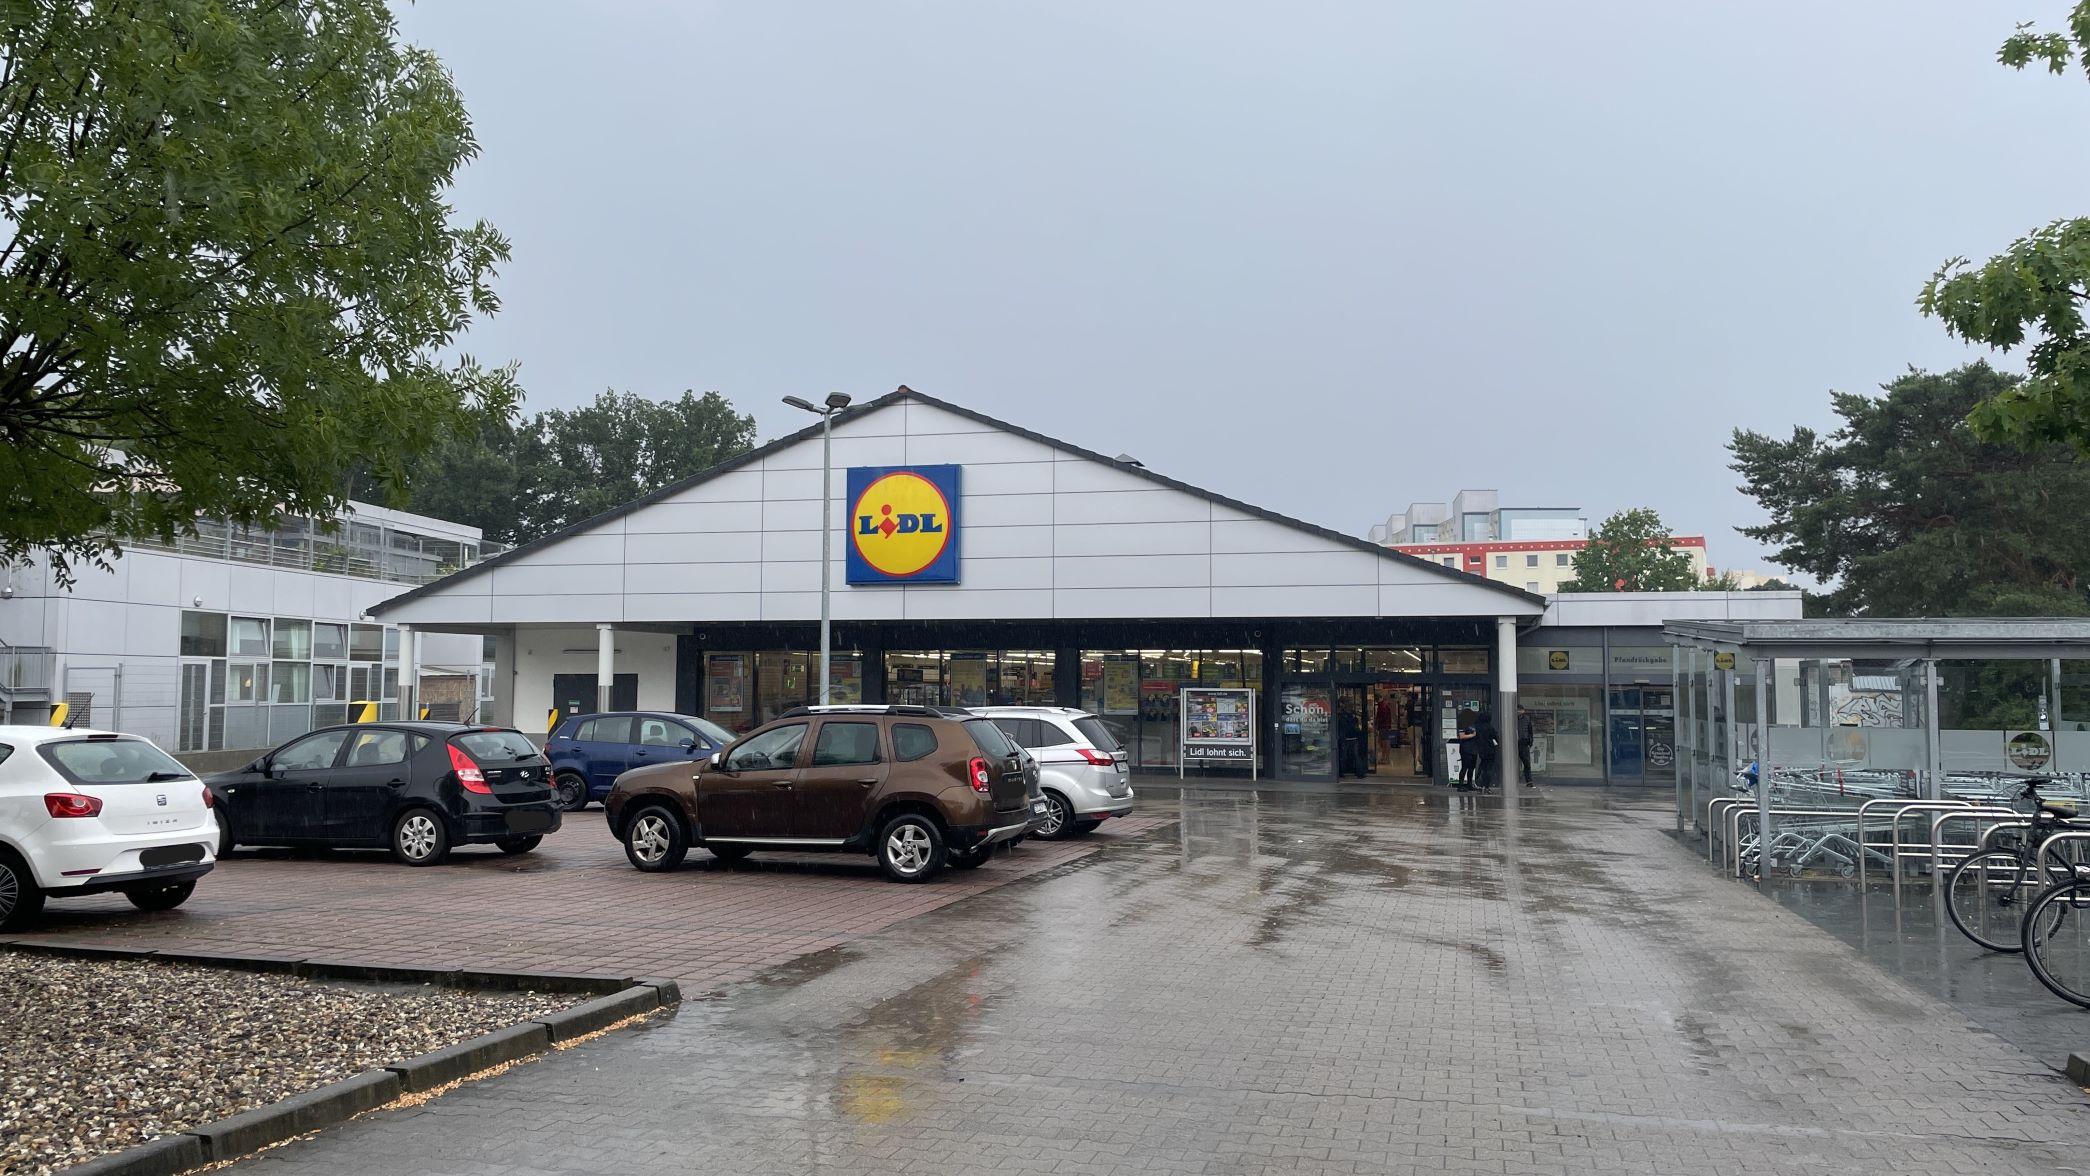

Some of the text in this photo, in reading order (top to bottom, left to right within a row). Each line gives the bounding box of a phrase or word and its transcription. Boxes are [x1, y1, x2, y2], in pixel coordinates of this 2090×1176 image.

[1614, 656, 1667, 664] Pfandrückgabe
[1285, 702, 1328, 716] Schön,
[1190, 747, 1246, 757] Lidl lohnt sich.
